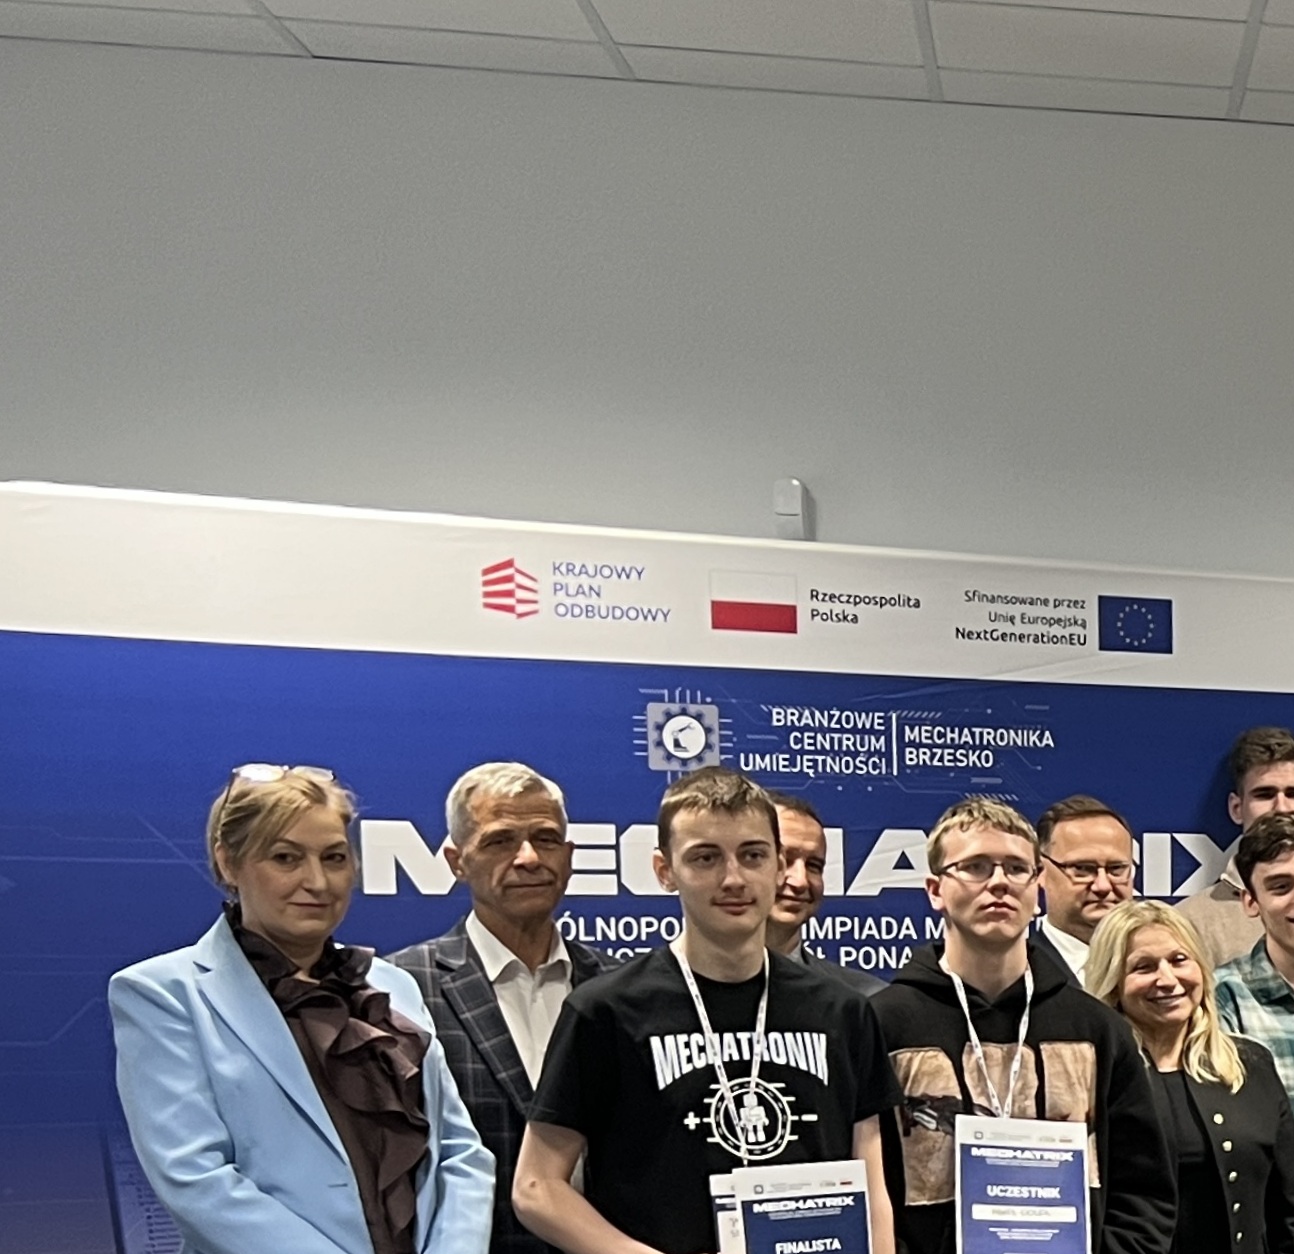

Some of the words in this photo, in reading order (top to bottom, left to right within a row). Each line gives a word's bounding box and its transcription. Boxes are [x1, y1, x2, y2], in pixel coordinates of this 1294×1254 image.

[552, 561, 646, 582] KRAJOWY
[553, 582, 602, 599] PLAN
[810, 588, 921, 609] Rzeczpospolita
[964, 590, 1050, 607] Sfinansowane
[1053, 597, 1086, 610] przez
[553, 602, 671, 623] ODBUDOWY
[810, 609, 859, 625] Polska
[987, 610, 1017, 626] Unię
[1020, 612, 1087, 631] Europejską
[955, 627, 1087, 647] NextGenerationEU
[771, 706, 886, 731] BRANŻOWE
[788, 731, 886, 753] CENTRUM
[904, 725, 1055, 748] MECHATRONIKA
[739, 753, 887, 777] UMIEJĘTNOŚCI
[904, 747, 994, 768] BRZESKO
[801, 916, 918, 941] IMPIADA
[649, 1031, 830, 1092] MECHATRONIK
[986, 1184, 1062, 1200] UCZESTNIK
[752, 1195, 856, 1214] MECHATRIX
